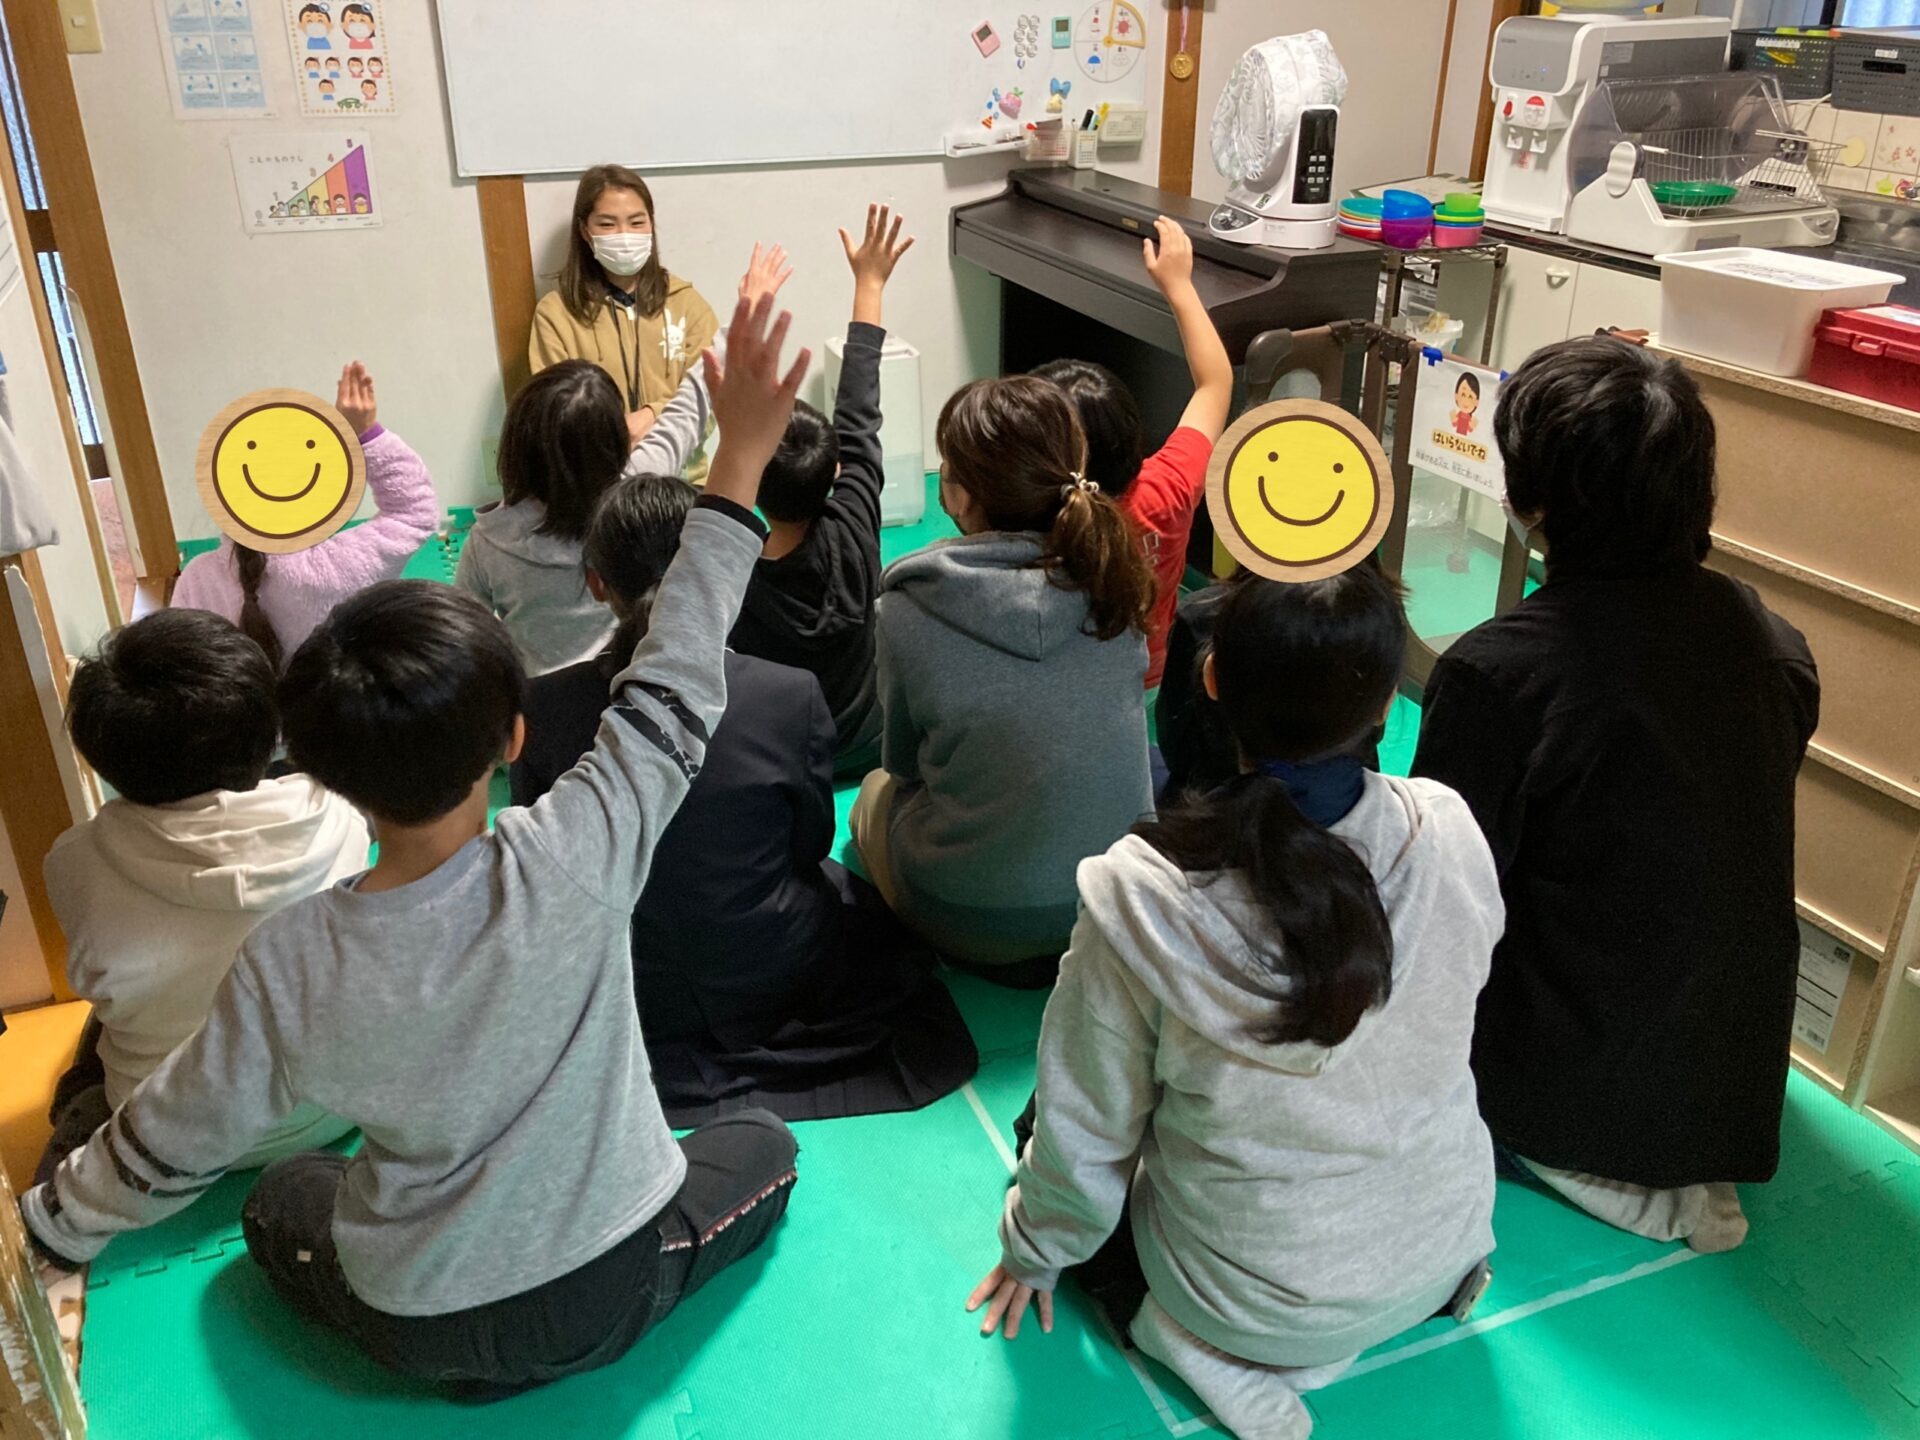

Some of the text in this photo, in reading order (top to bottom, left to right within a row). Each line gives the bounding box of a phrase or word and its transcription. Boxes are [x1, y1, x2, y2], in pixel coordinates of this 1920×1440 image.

[291, 181, 299, 191] 2
[273, 192, 279, 201] 1
[1432, 431, 1486, 460] はいらないでね
